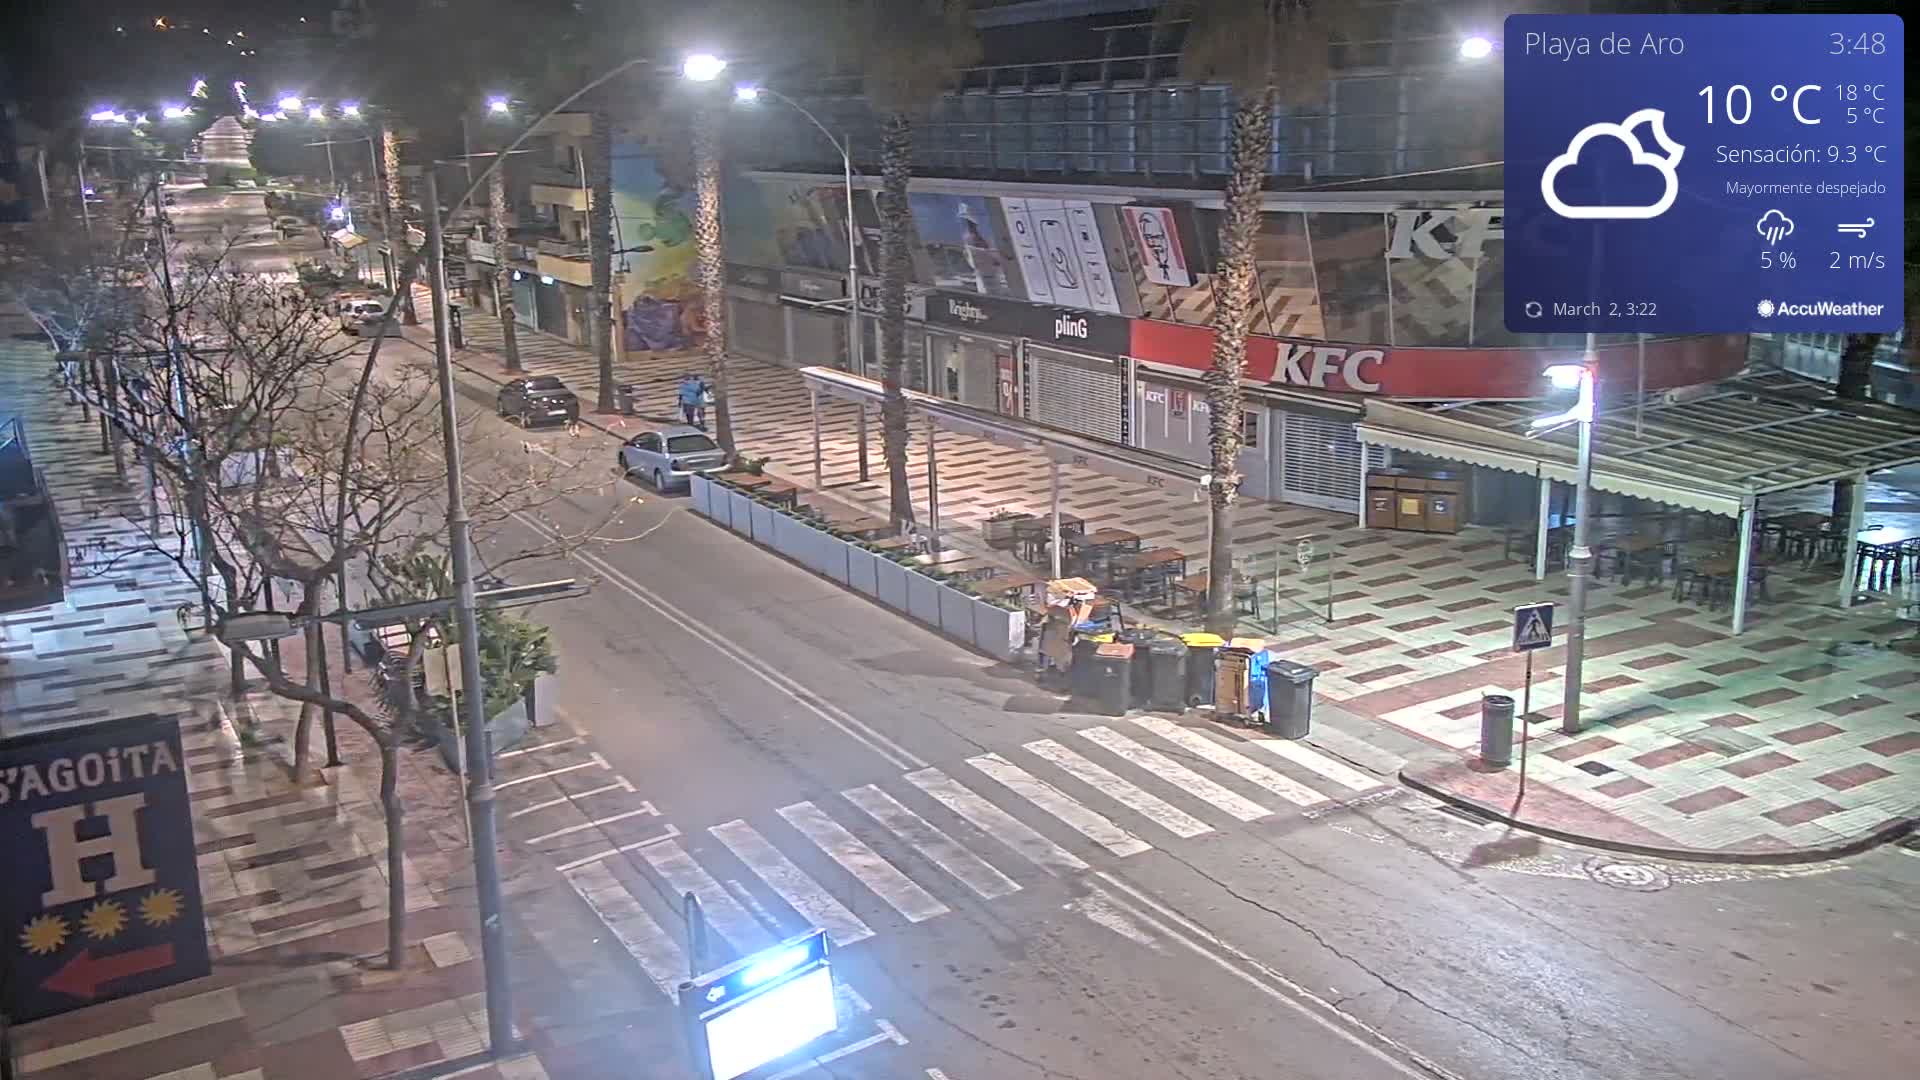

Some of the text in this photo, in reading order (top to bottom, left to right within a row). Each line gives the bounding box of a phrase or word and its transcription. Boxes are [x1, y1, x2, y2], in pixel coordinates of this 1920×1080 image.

[1388, 208, 1504, 259] KF
[1055, 314, 1088, 339] plinG
[1271, 342, 1384, 393] KFC
[1146, 390, 1165, 403] KFC
[31, 792, 157, 909] H
